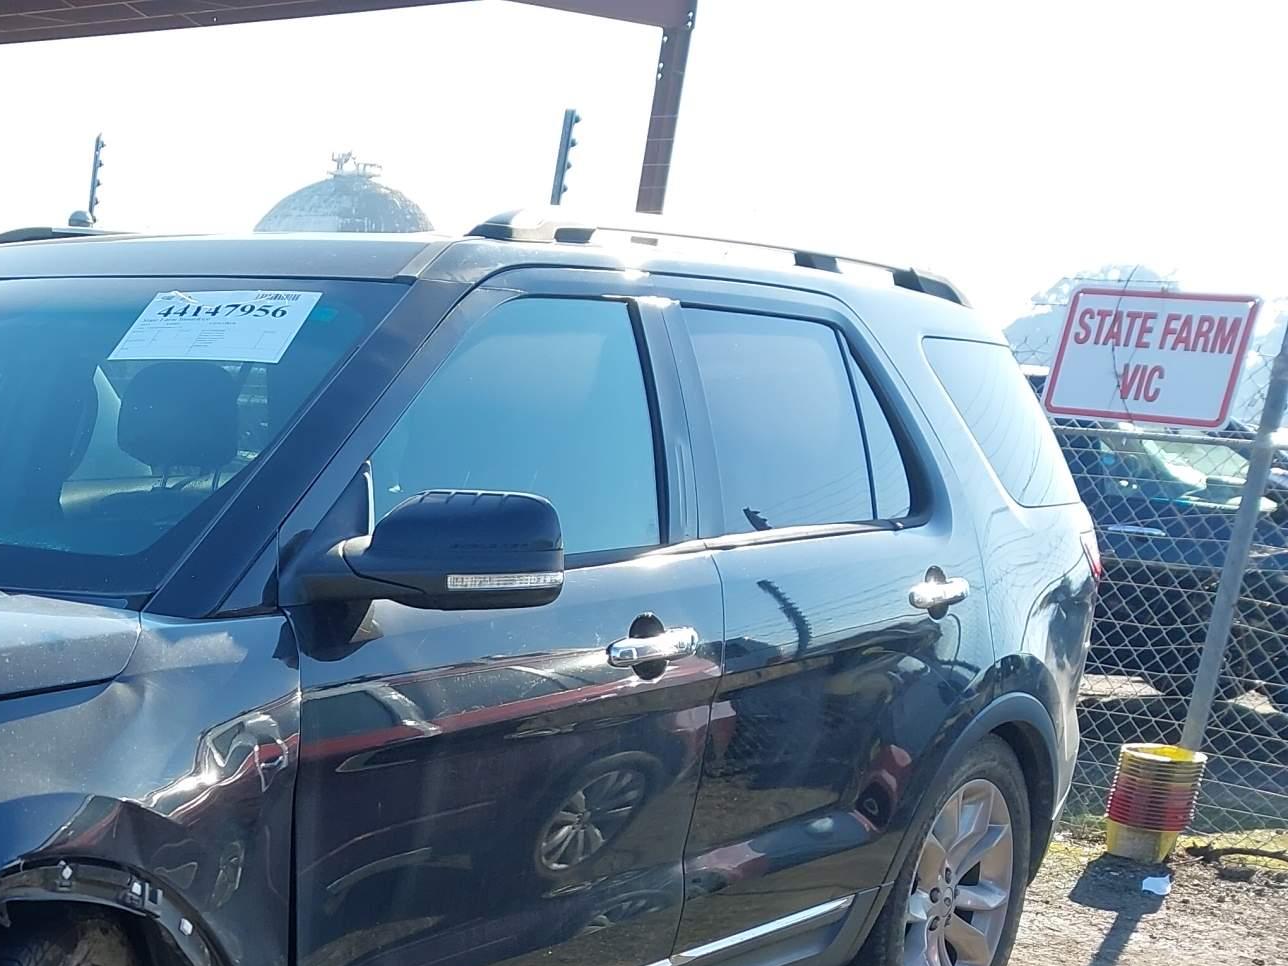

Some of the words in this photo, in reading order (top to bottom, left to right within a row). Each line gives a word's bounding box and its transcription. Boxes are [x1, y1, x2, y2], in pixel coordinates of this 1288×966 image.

[157, 303, 290, 318] 44147956
[1074, 308, 1158, 349] STATE
[1160, 313, 1242, 355] FARM
[1119, 363, 1164, 402] VIC
